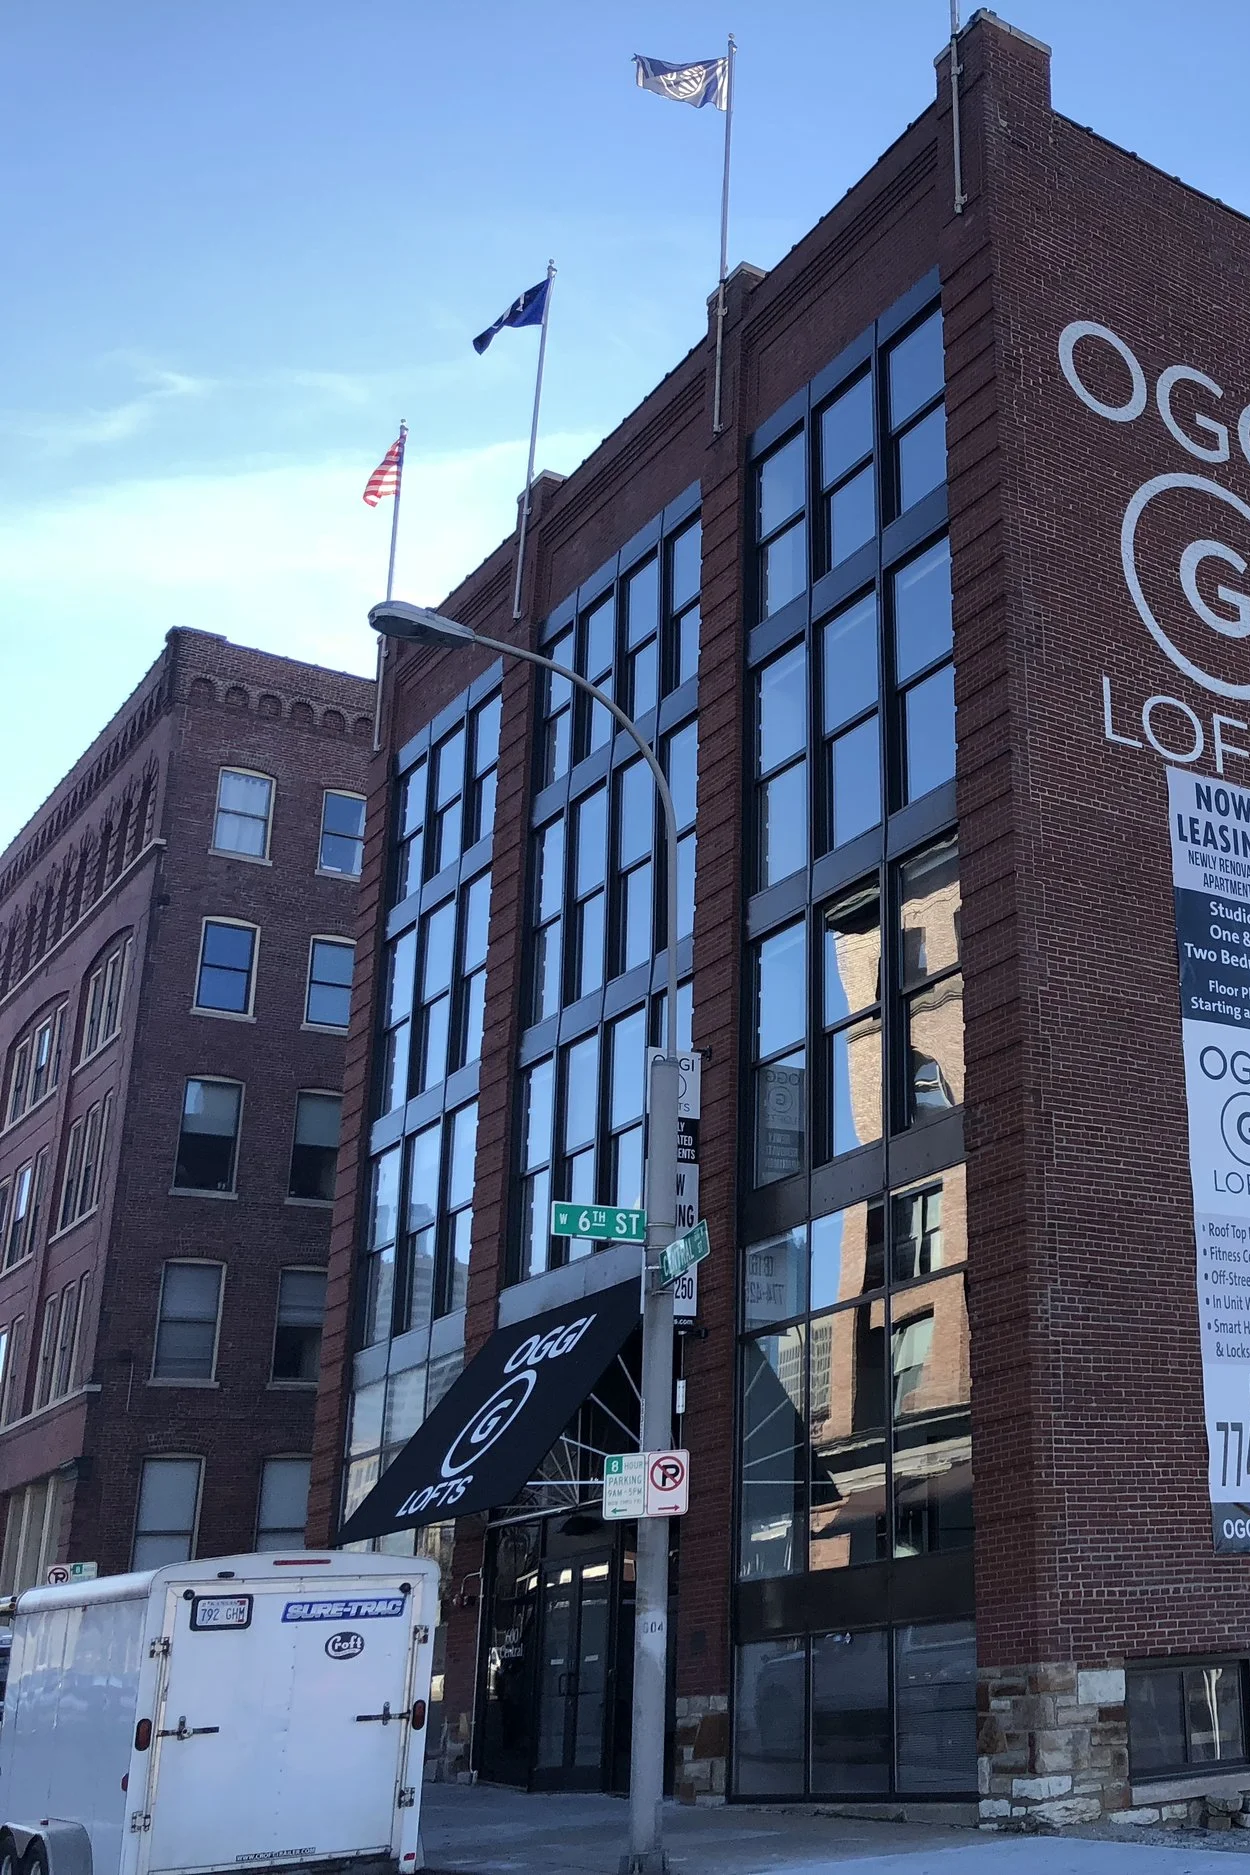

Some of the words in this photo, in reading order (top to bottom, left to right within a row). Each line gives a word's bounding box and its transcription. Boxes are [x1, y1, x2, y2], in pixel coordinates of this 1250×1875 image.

[1188, 849, 1217, 870] NEWLY
[1210, 925, 1240, 944] One
[1184, 943, 1217, 962] Two
[1209, 980, 1239, 997] Floor
[1191, 996, 1242, 1021] Starting
[559, 1213, 568, 1224] W
[578, 1210, 606, 1231] 6TH
[615, 1212, 640, 1235] ST
[1208, 1222, 1230, 1238] Roof
[1232, 1225, 1247, 1241] Top
[1210, 1246, 1241, 1263] Fitness
[1212, 1297, 1222, 1309] In
[1223, 1295, 1243, 1311] Unit
[1214, 1319, 1241, 1335] Smart
[503, 1313, 598, 1373] OGGI
[1216, 1342, 1224, 1357] &
[1226, 1343, 1250, 1358] Locks
[470, 1399, 513, 1443] G
[611, 1460, 619, 1472] 8
[624, 1461, 643, 1470] HOUR
[608, 1475, 642, 1487] PARKING
[395, 1475, 473, 1518] LOFTS
[201, 1608, 220, 1621] 792
[286, 1600, 402, 1619] SURE-TRAC
[328, 1635, 362, 1654] Croft
[500, 1642, 523, 1659] Central
